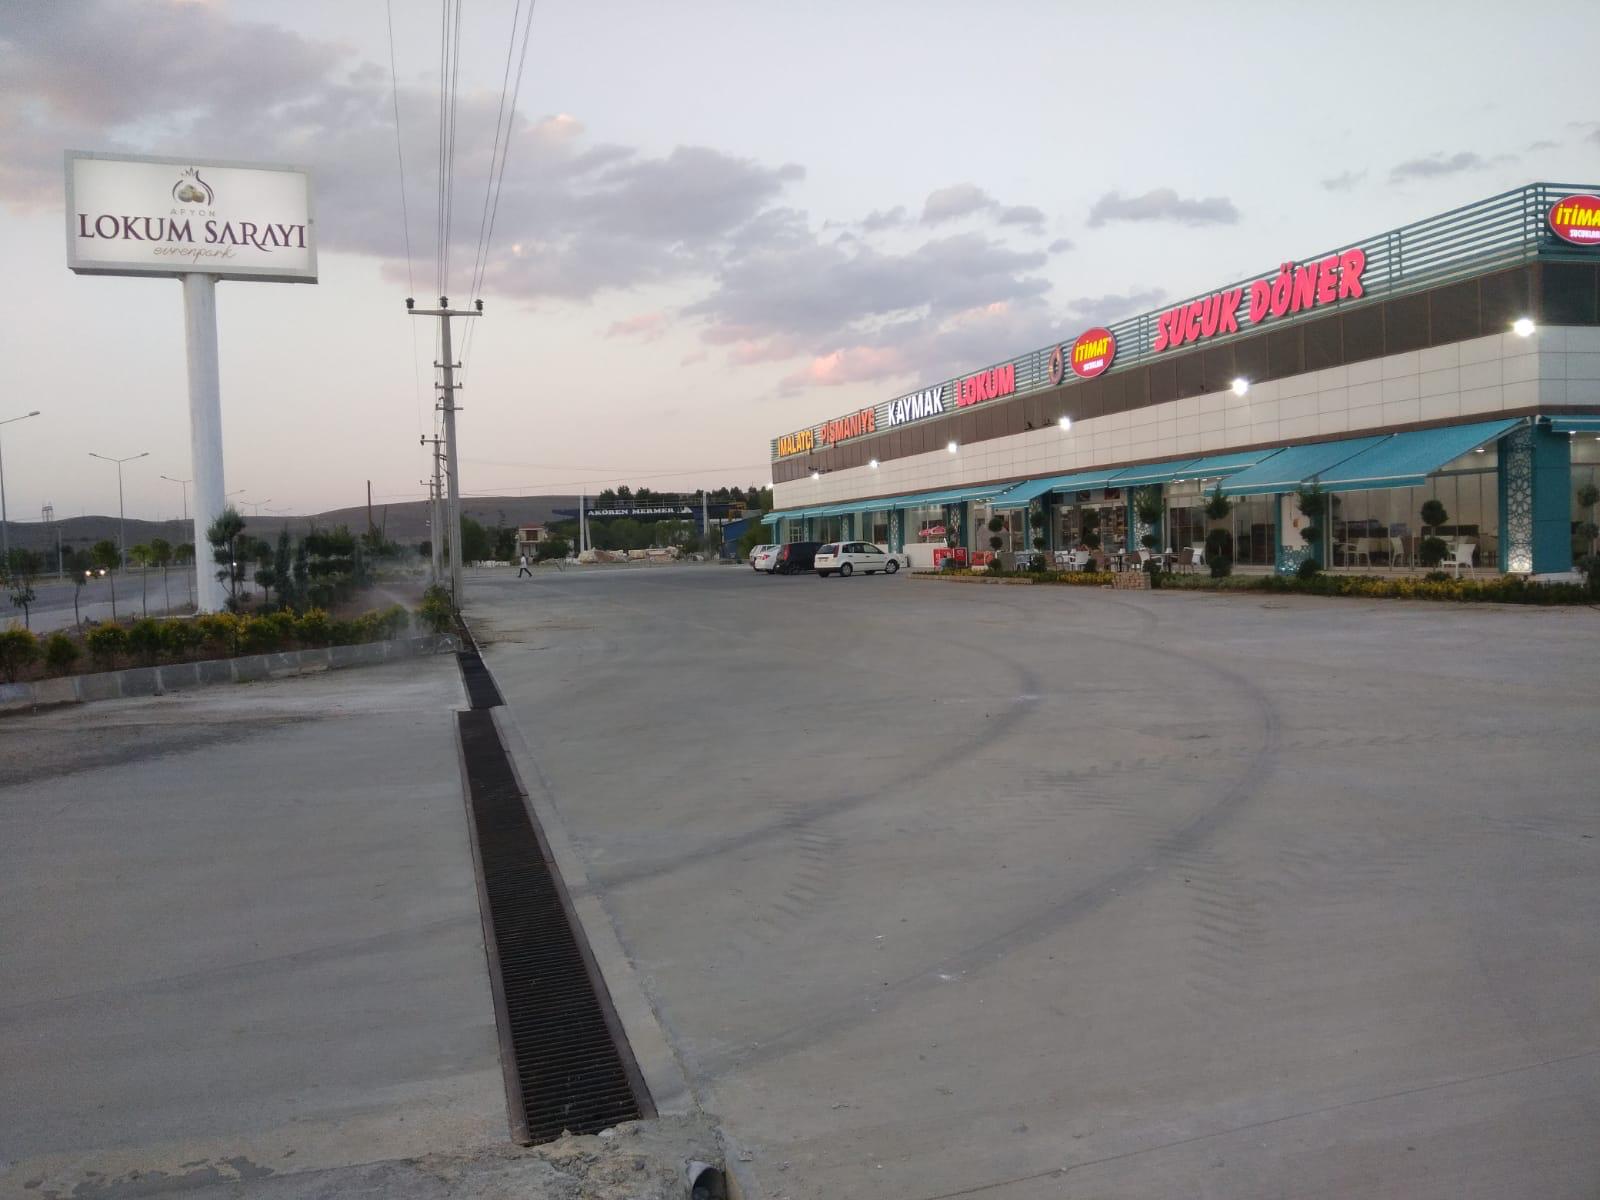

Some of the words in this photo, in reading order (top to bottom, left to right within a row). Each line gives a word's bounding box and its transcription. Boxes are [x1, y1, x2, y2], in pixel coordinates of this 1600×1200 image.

[170, 208, 215, 217] AFYON
[78, 213, 196, 243] LOKUM
[204, 220, 307, 252] SARAYI
[1153, 286, 1244, 352] SUCUK
[1249, 248, 1366, 324] DÖNER
[1075, 337, 1109, 363] İTİMAT
[956, 364, 1017, 407] LOKUM
[888, 387, 944, 426] KAYMAK
